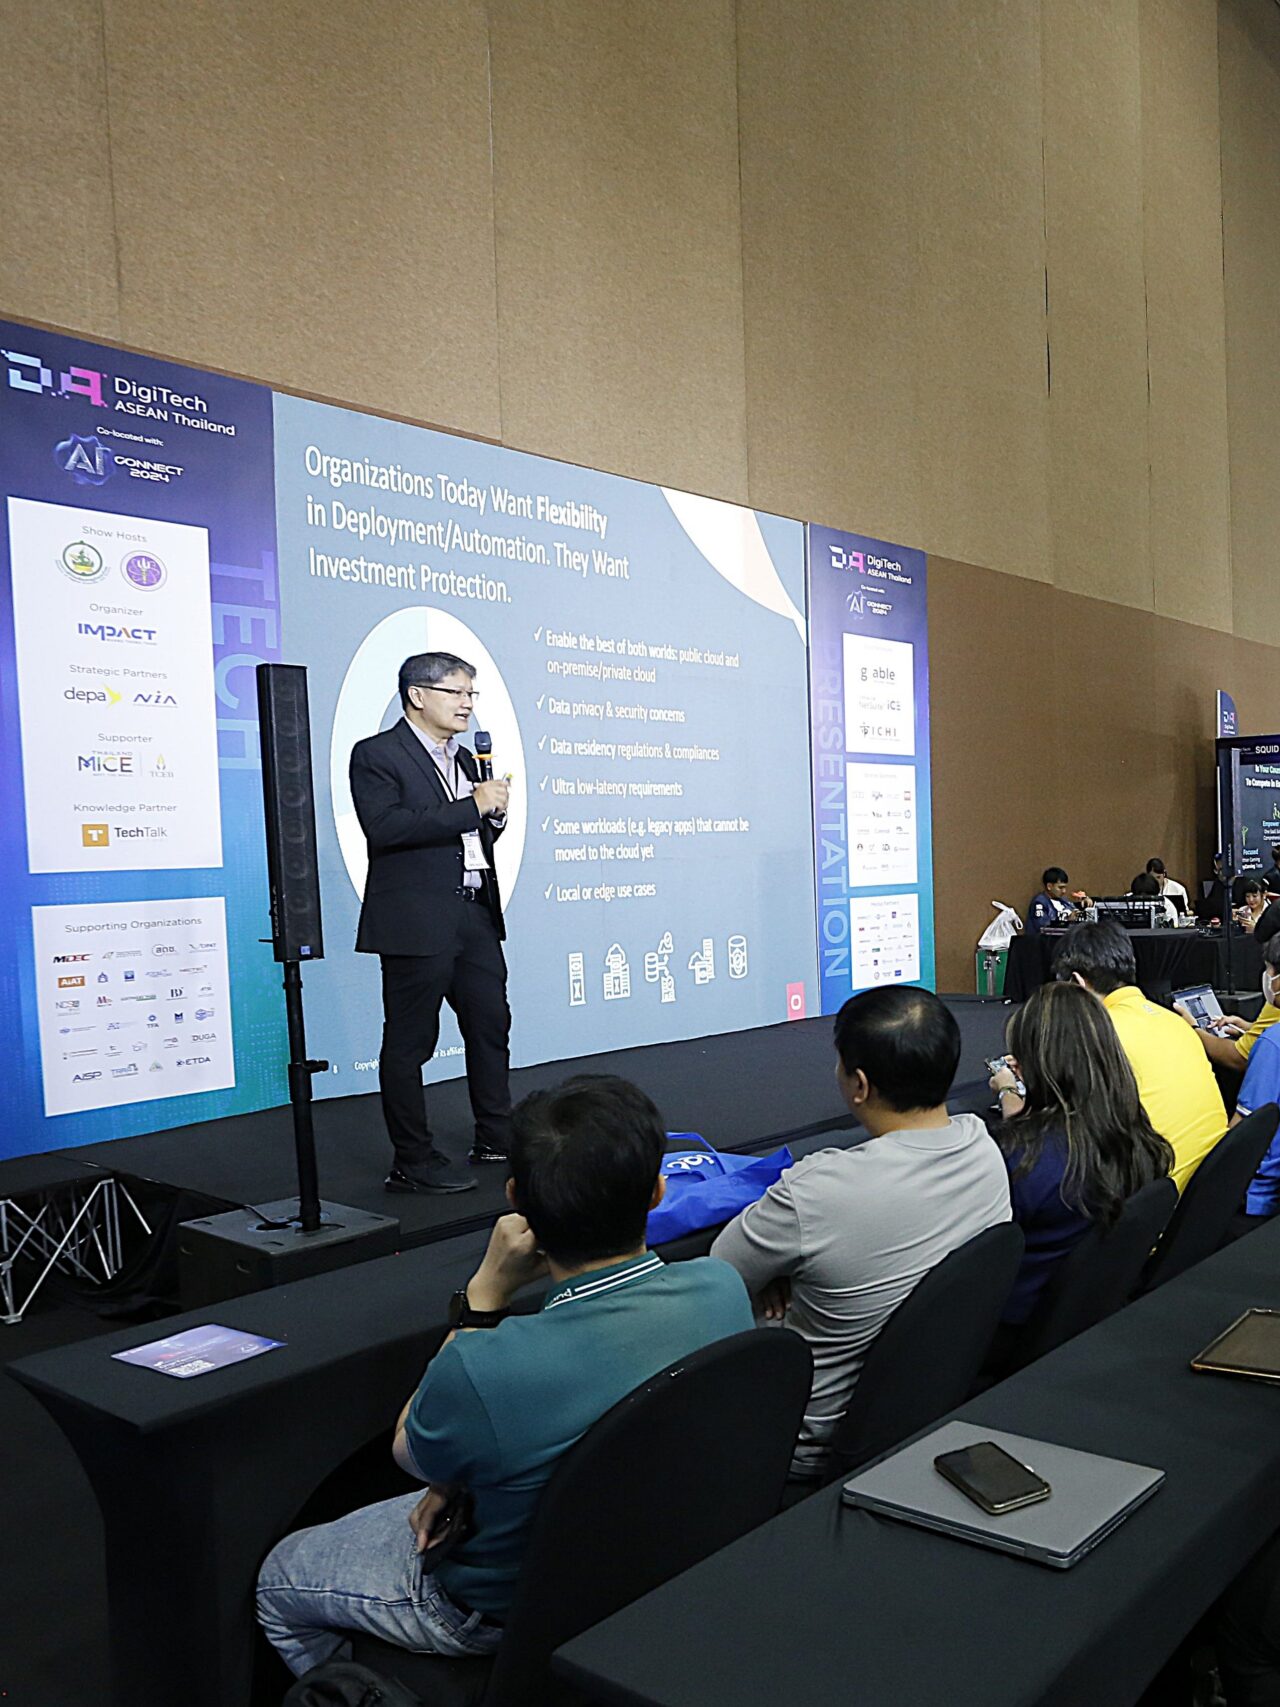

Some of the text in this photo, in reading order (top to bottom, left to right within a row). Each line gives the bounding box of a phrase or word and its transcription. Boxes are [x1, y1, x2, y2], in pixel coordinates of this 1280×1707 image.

[114, 377, 208, 412] DigiTech
[114, 401, 236, 436] ASEAN Thailand
[96, 426, 164, 446] Co-located with:
[114, 456, 184, 476] CONNECT
[130, 468, 170, 483] 2024
[305, 445, 608, 540] Organizations Today Want Flexibility
[82, 526, 147, 543] Show Hosts
[306, 495, 630, 580] in Deployment/Automation. They Want
[867, 555, 901, 572] DigiTech
[309, 548, 512, 603] Investment Protection.
[867, 569, 911, 584] ASEAN Thailand
[90, 603, 143, 616] Organizer
[78, 623, 157, 641] IMPACT
[546, 630, 739, 668] Enable the best of both worlds: public cloud and
[70, 665, 167, 680] Strategic Partners
[547, 660, 656, 683] on-premise/private cloud
[64, 687, 106, 704] depa
[549, 697, 685, 723] Data privacy & security concerns
[98, 733, 152, 744] Supporter
[551, 738, 719, 762] Data residency regulations & compliances
[1255, 745, 1279, 754] SQUID
[78, 755, 133, 773] MICE
[552, 777, 682, 798] Ultra low-latency requirements
[74, 803, 176, 813] Knowledge Partner
[819, 643, 849, 978] PRESENTATION
[115, 827, 168, 838] TechTalk
[553, 816, 749, 837] Some workloads (e.g. legacy apps) that cannot be
[555, 842, 654, 862] moved to the cloud yet
[557, 882, 656, 903] Local or edge use cases
[65, 917, 202, 933] Supporting Organizations
[185, 1057, 211, 1066] ETDA
[354, 1059, 380, 1072] Copyrigh
